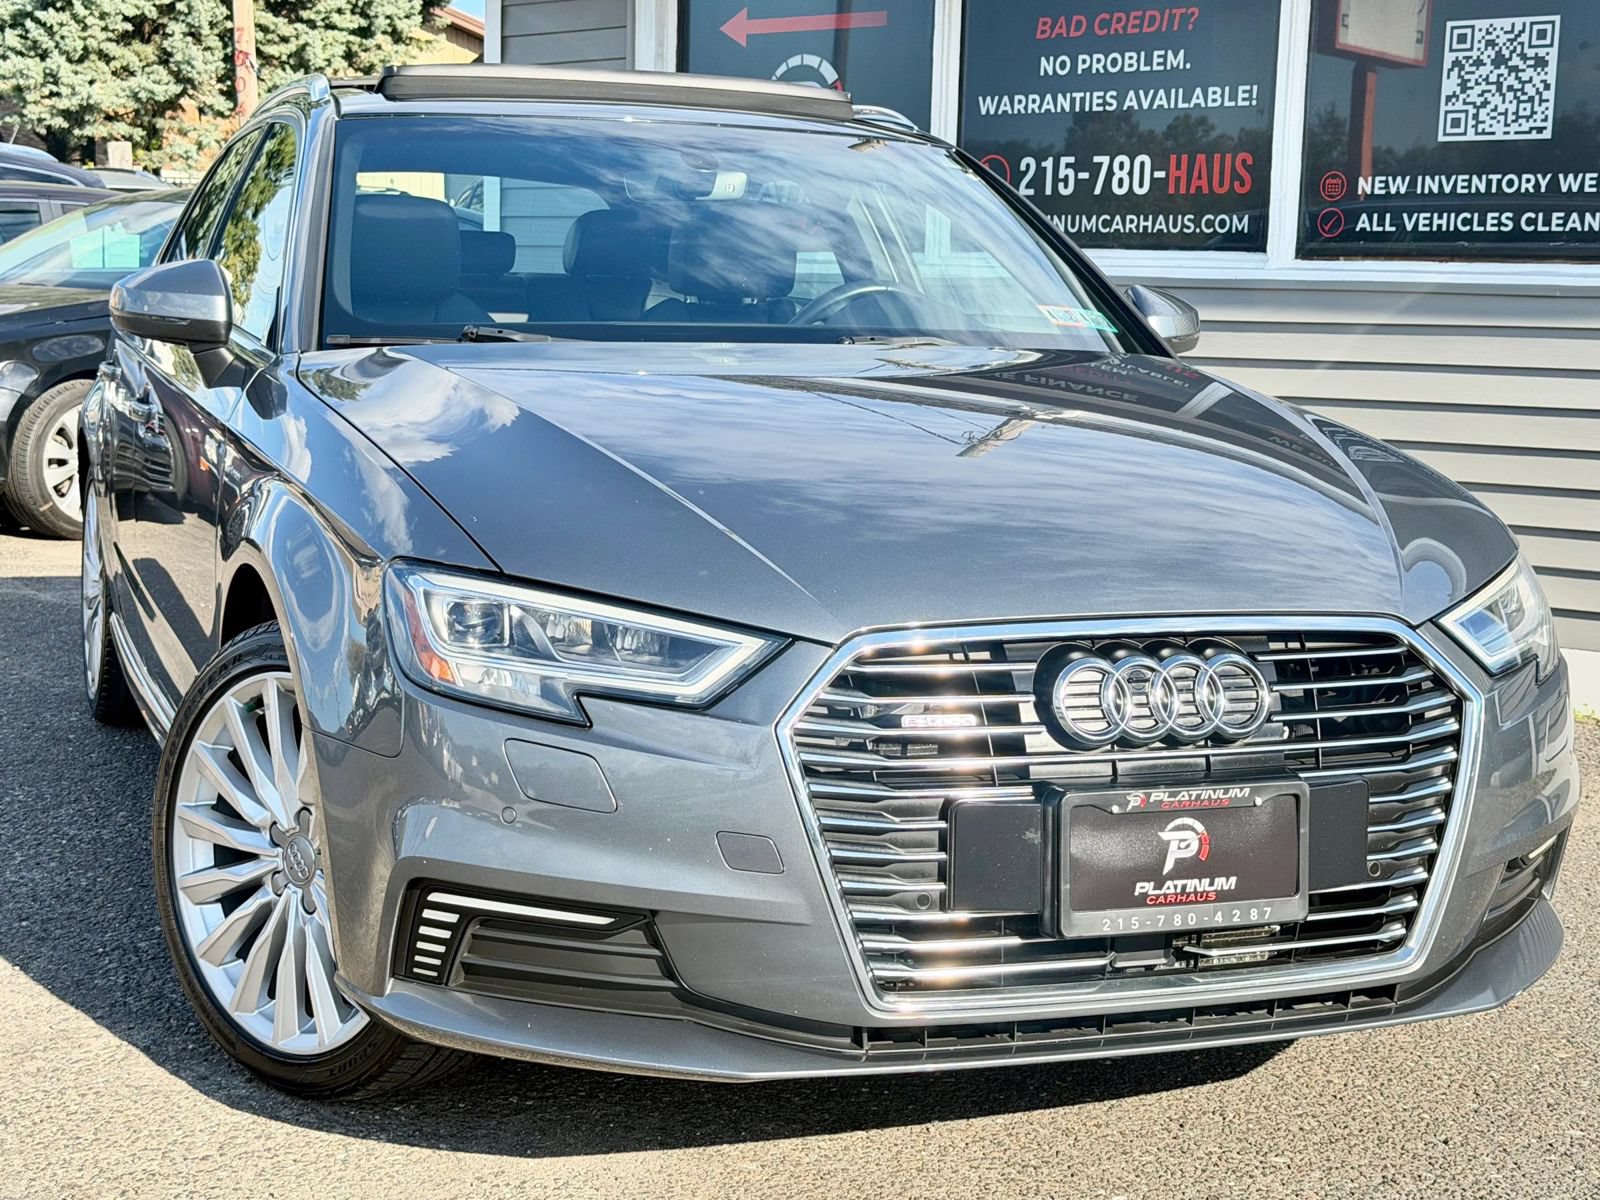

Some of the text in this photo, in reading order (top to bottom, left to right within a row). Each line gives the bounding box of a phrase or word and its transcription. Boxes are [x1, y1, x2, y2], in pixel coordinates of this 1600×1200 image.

[1035, 7, 1200, 40] BAD CREDIT?
[1040, 49, 1192, 76] NO PROBLEM.
[978, 85, 1259, 115] WARRANTIES AVAILABLE!
[1018, 152, 1254, 196] 215-780-HAUS
[1357, 175, 1411, 195] NEW
[1416, 173, 1553, 194] INVENTORY
[1355, 211, 1600, 232] ALL VEHICLES CLEAN
[1150, 788, 1251, 803] PLATINUM
[1161, 800, 1232, 810] CARHAUS
[1134, 876, 1238, 896] PLATINUM
[1146, 891, 1217, 905] CARHAUS
